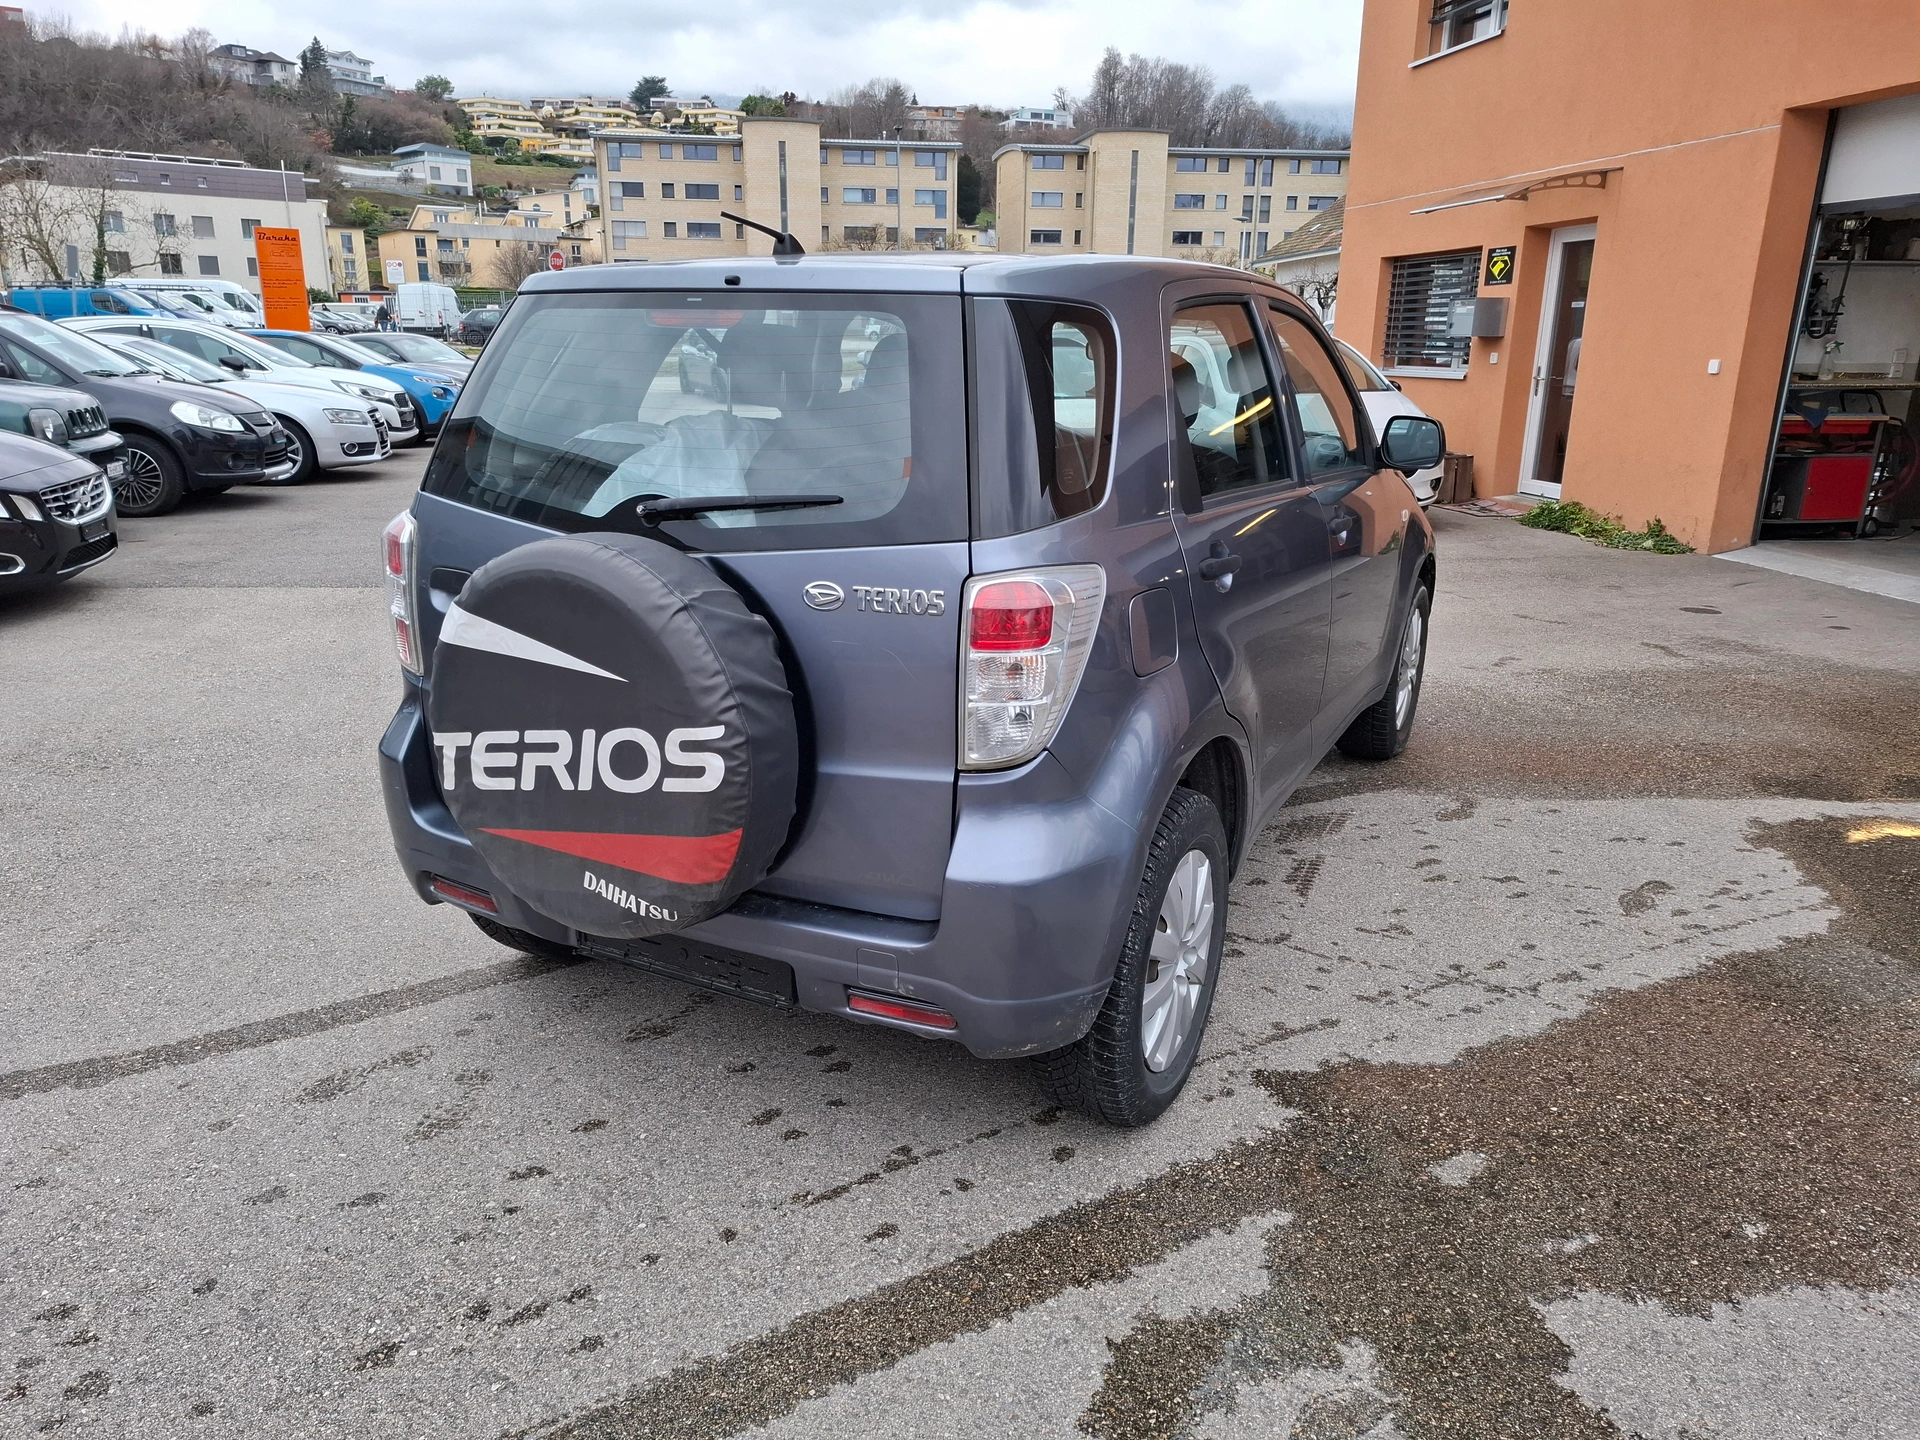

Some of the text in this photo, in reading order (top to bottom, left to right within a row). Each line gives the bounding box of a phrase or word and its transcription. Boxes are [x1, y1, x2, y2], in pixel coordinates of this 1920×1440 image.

[256, 231, 297, 242] Baraka
[551, 257, 563, 266] STOP
[852, 586, 946, 616] TERIOS
[432, 725, 726, 794] TERIOS
[583, 871, 678, 923] DAIHATSU
